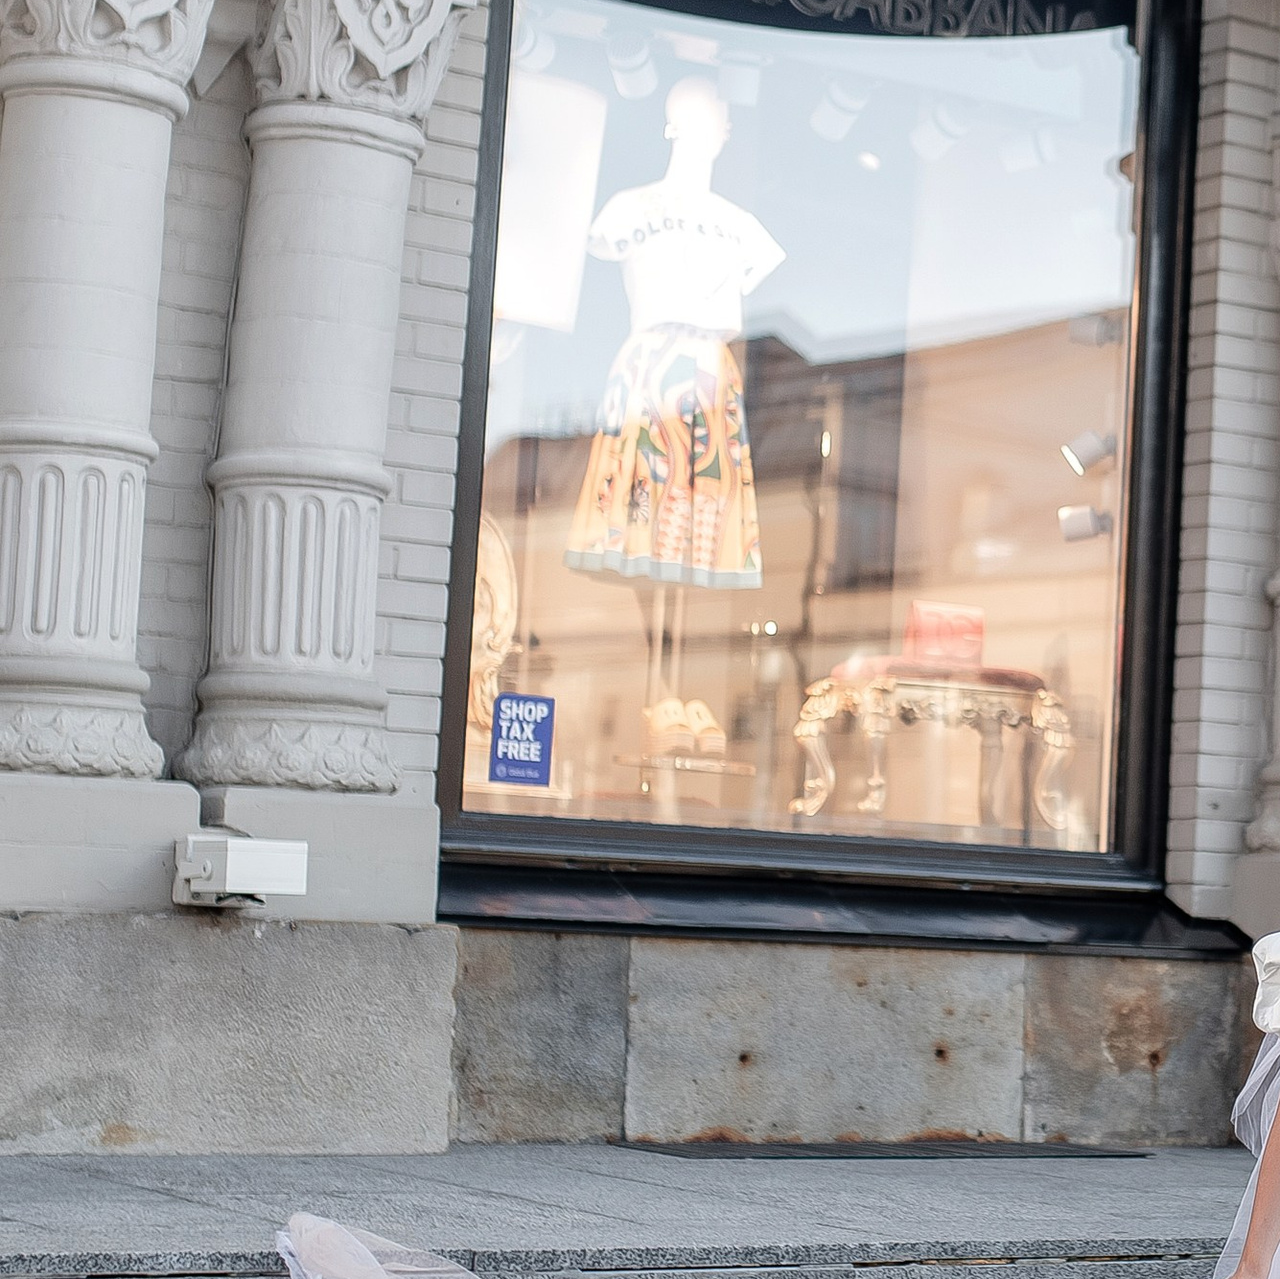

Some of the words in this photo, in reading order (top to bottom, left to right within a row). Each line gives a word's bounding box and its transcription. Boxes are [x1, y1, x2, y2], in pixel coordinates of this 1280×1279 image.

[500, 698, 549, 723] SHOP
[499, 719, 536, 741] TAX
[497, 738, 541, 762] FREE
